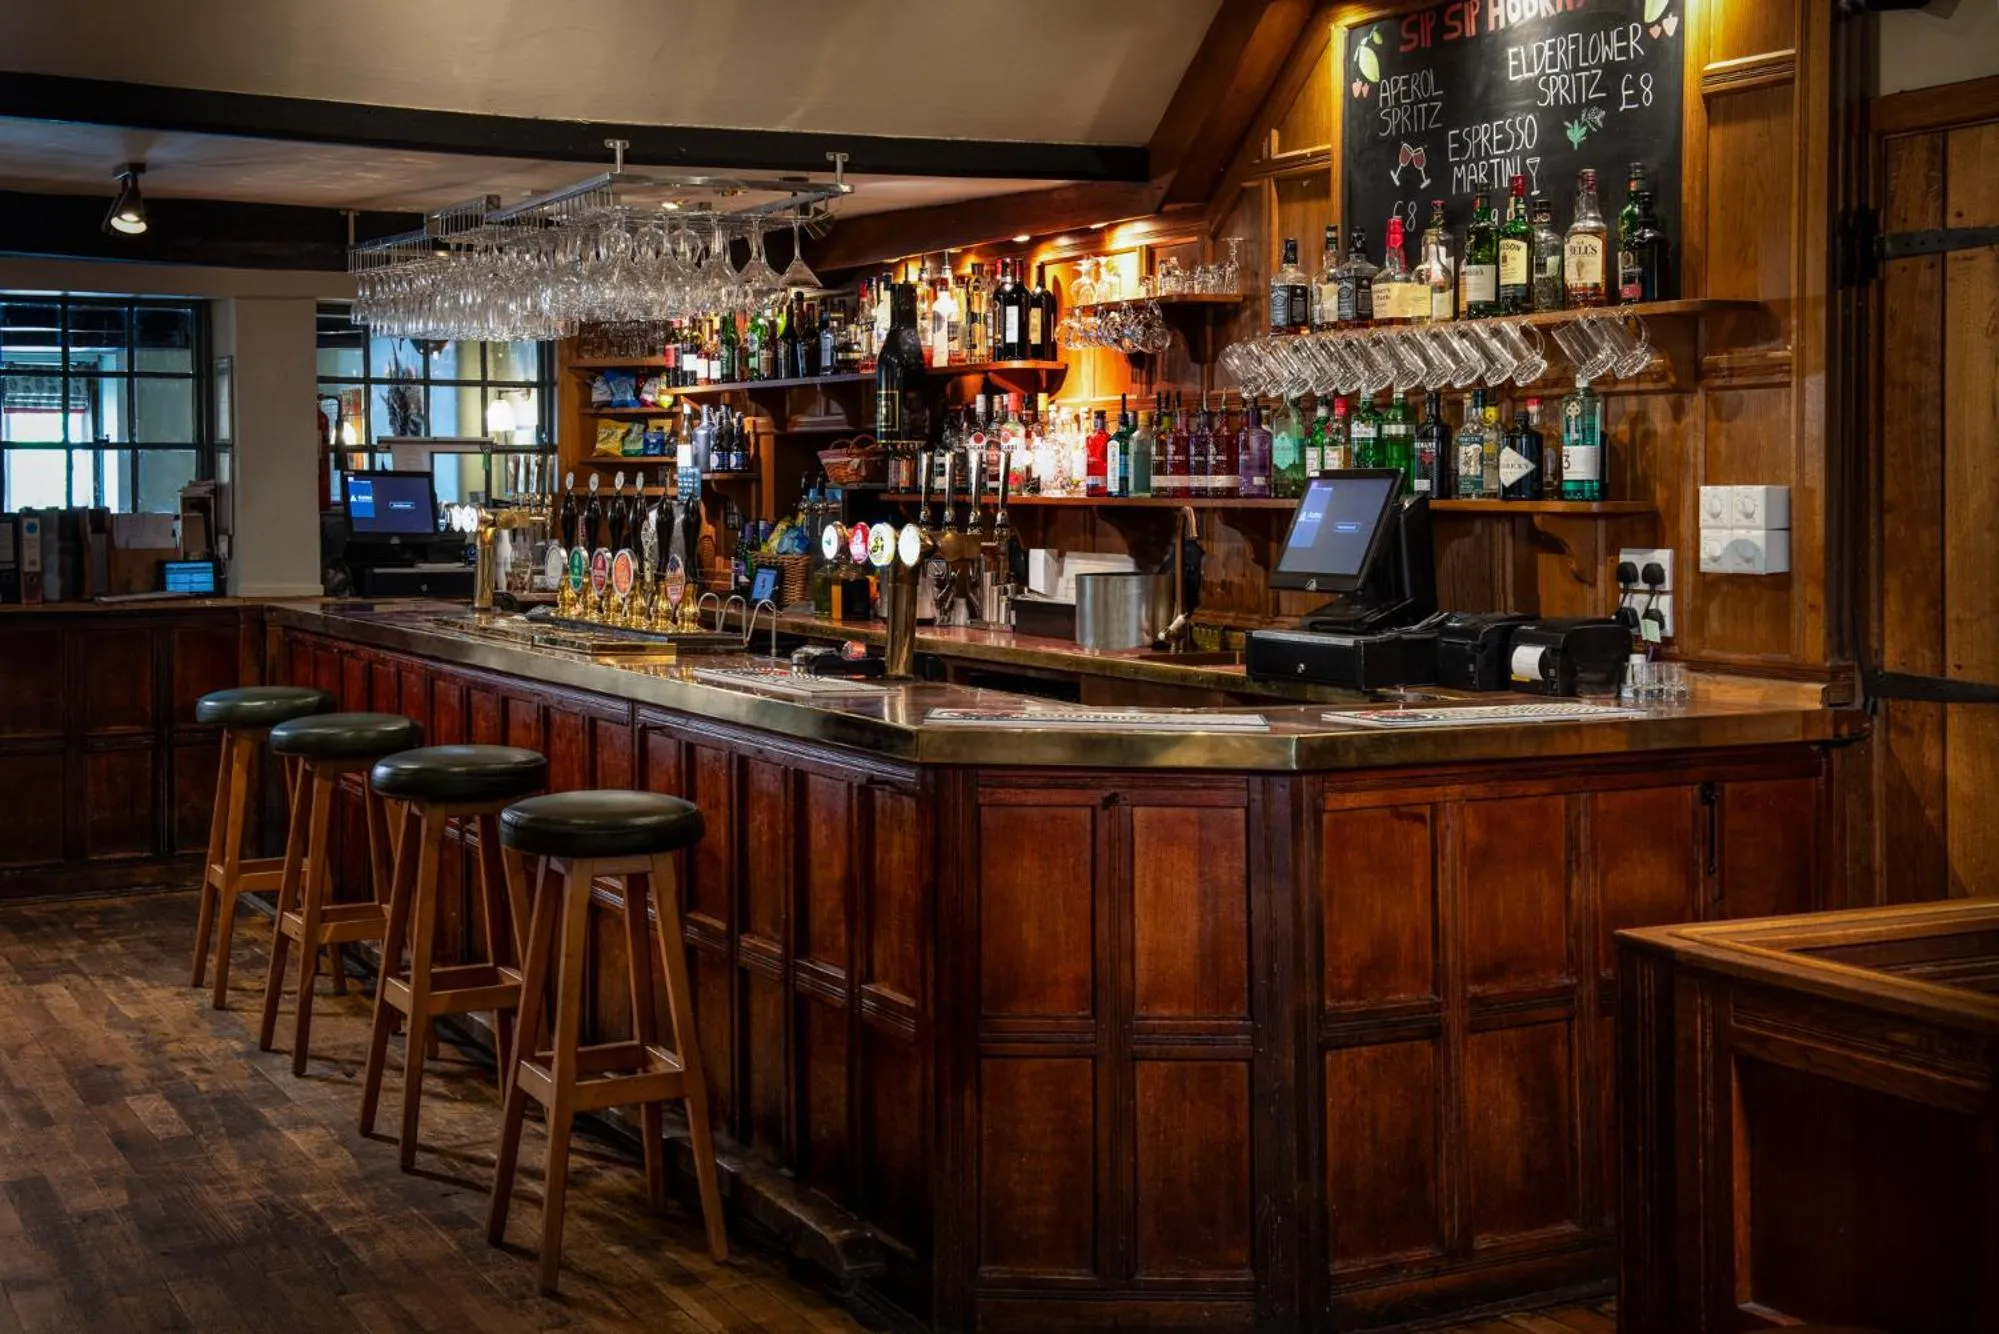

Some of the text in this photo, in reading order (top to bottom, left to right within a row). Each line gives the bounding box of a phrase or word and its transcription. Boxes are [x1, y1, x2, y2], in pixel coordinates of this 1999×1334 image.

[1400, 11, 1436, 53] SIP
[1443, 1, 1480, 41] SIP
[1508, 23, 1645, 81] ELDERFLOWER
[1379, 68, 1444, 108] APEROL
[1537, 69, 1654, 112] SPRITZ £8
[1378, 102, 1443, 137] SPRITZ
[1448, 115, 1537, 162] ESPRESSO
[1452, 155, 1521, 196] MARTINI
